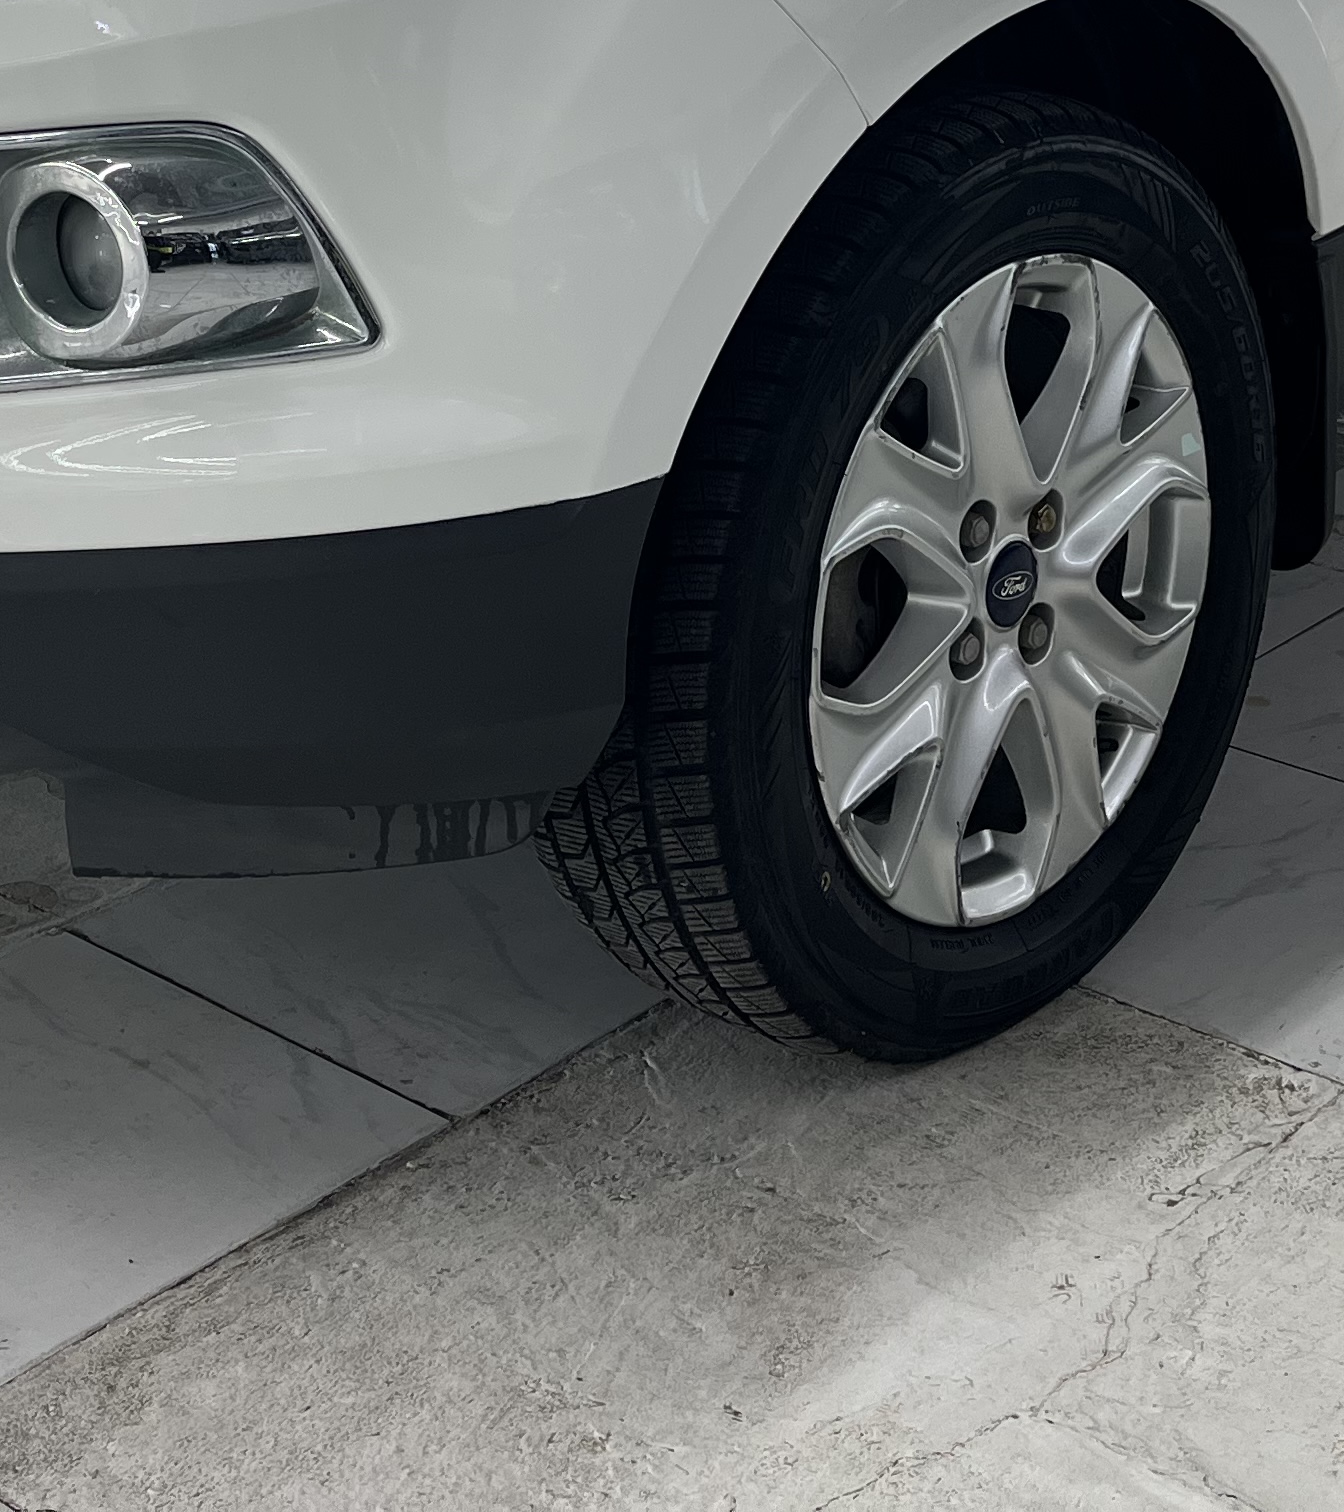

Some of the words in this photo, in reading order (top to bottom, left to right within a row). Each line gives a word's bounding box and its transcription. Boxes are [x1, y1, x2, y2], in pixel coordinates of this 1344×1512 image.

[1026, 196, 1081, 217] OUTSIDE
[1189, 239, 1267, 464] 205/60R16
[1000, 576, 1027, 597] Ford
